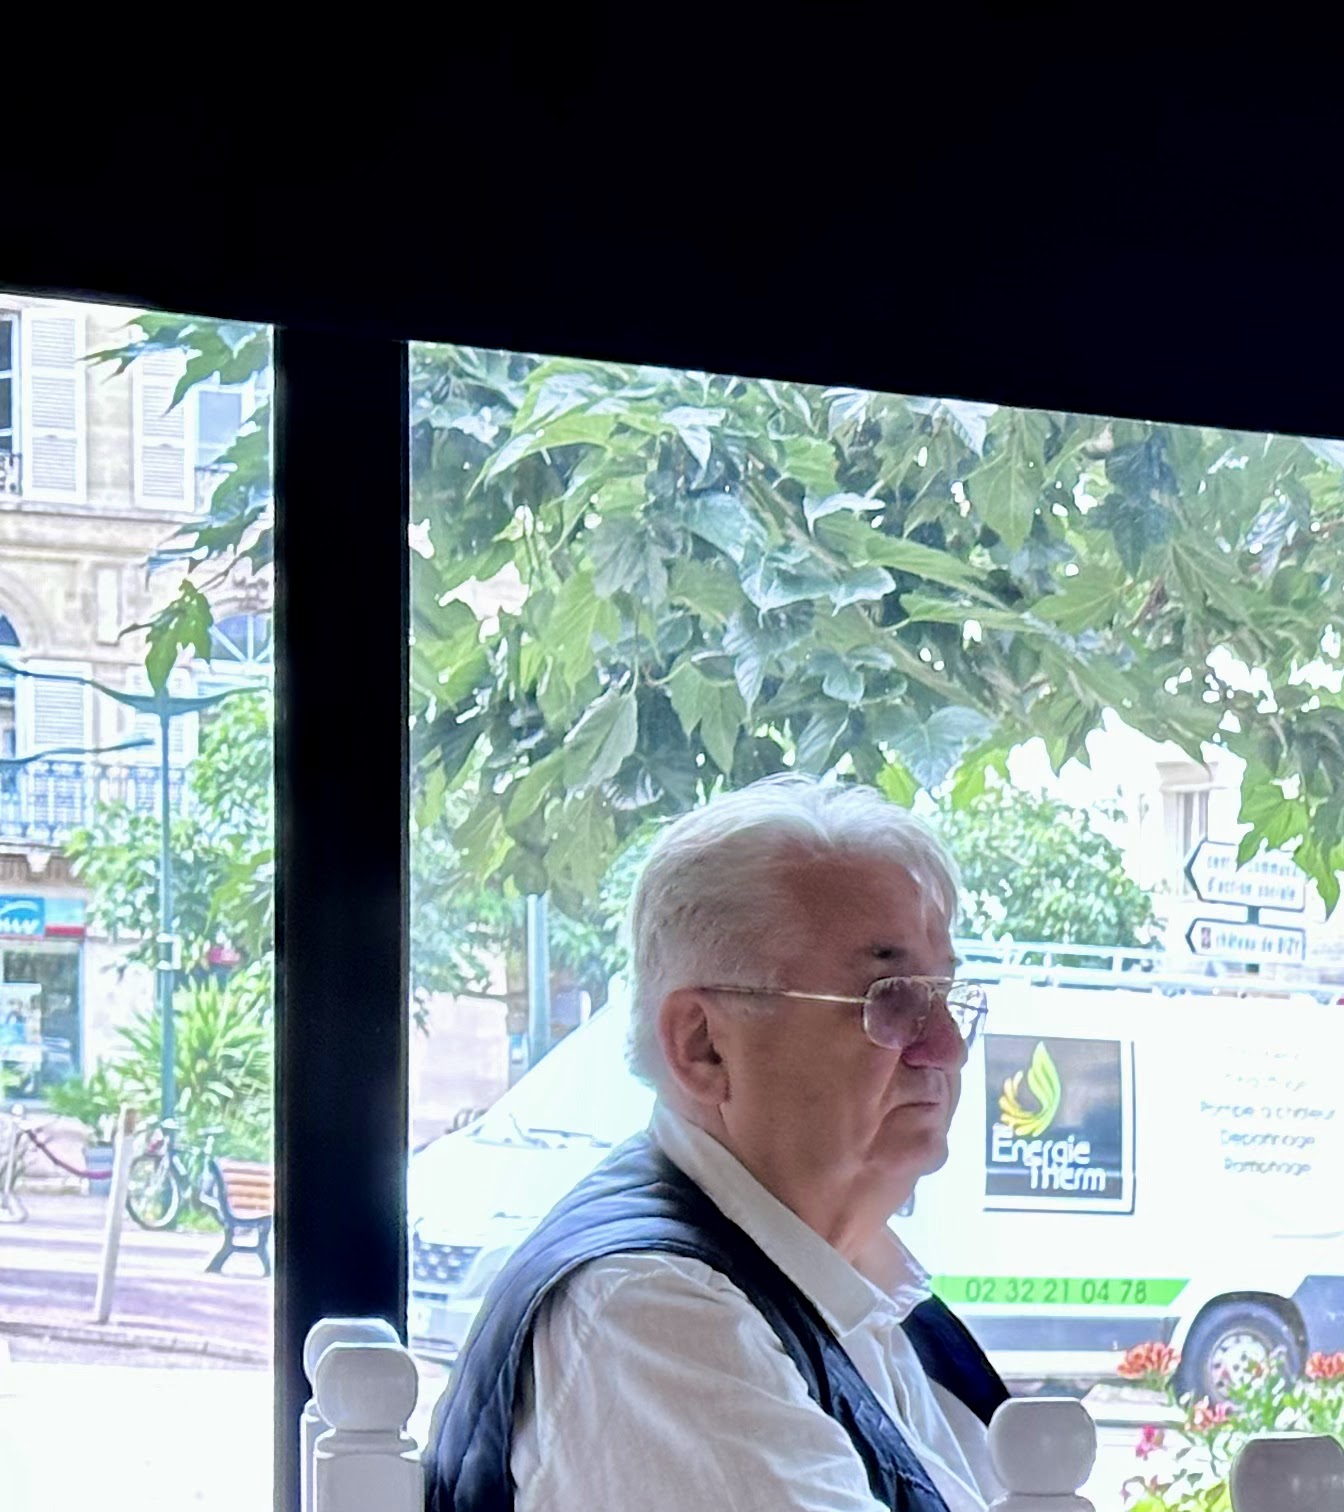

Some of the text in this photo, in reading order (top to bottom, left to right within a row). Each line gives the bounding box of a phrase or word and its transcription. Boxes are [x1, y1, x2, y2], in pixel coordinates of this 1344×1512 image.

[966, 1279, 1147, 1303] 02 32 21 04 78
